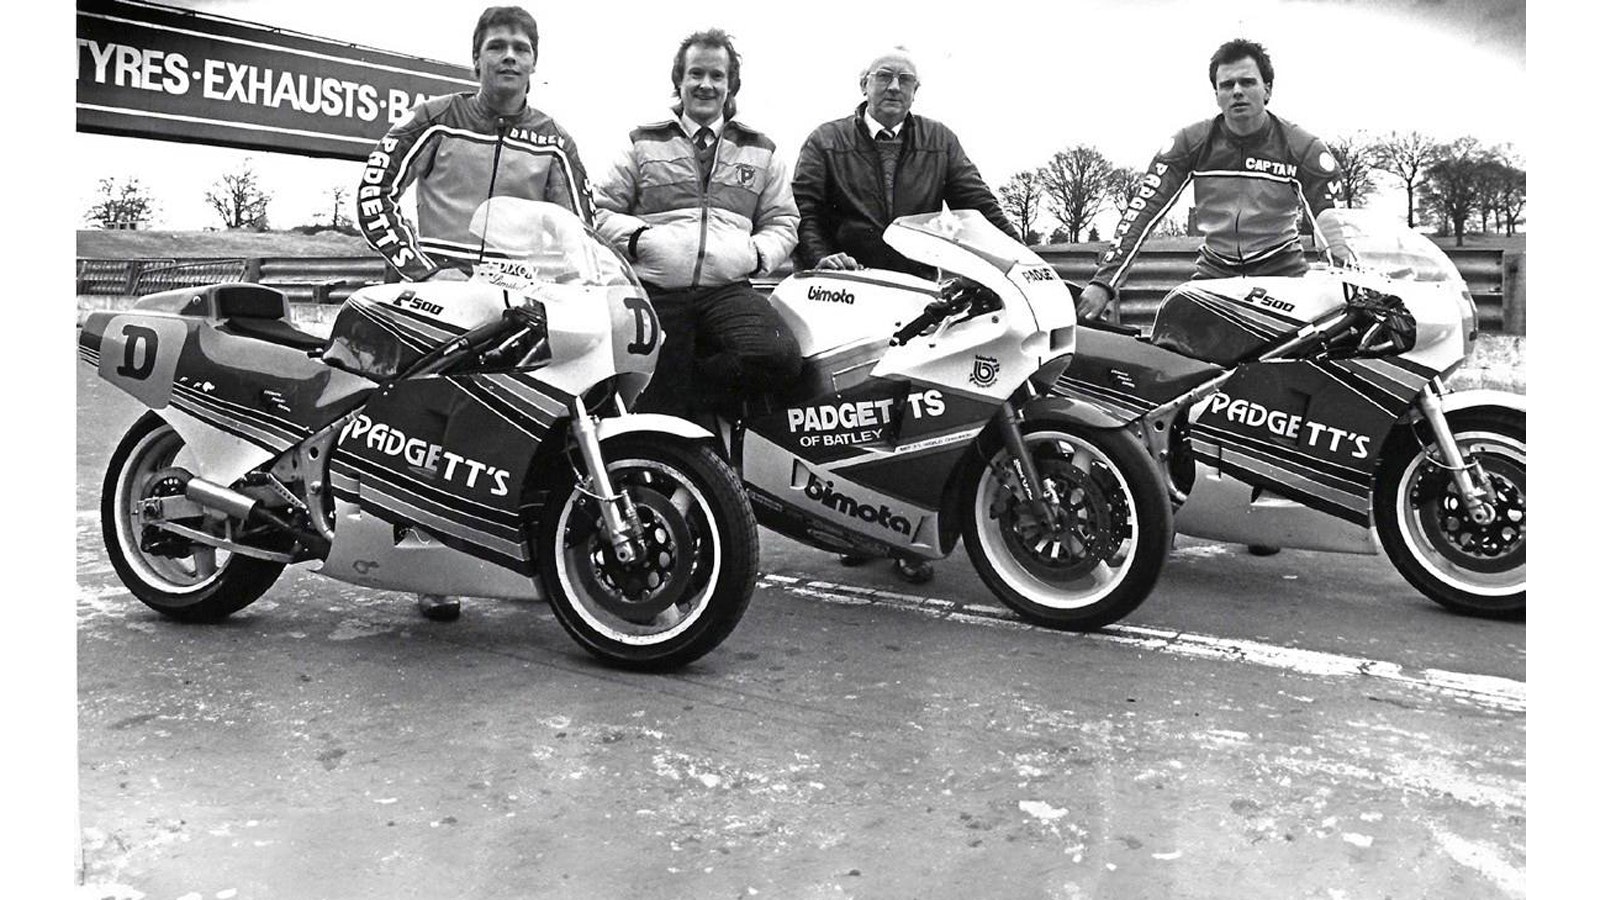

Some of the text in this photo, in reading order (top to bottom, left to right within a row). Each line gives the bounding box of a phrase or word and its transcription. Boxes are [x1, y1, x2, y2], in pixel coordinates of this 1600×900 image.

[203, 58, 379, 121] EXHAUSTS
[509, 128, 565, 148] DARREN
[1021, 268, 1056, 284] PADGE
[807, 286, 856, 305] bimota
[623, 297, 658, 355] D
[117, 324, 159, 381] D
[800, 435, 820, 448] OF
[823, 429, 883, 447] BATLEY
[804, 472, 911, 536] bimota
